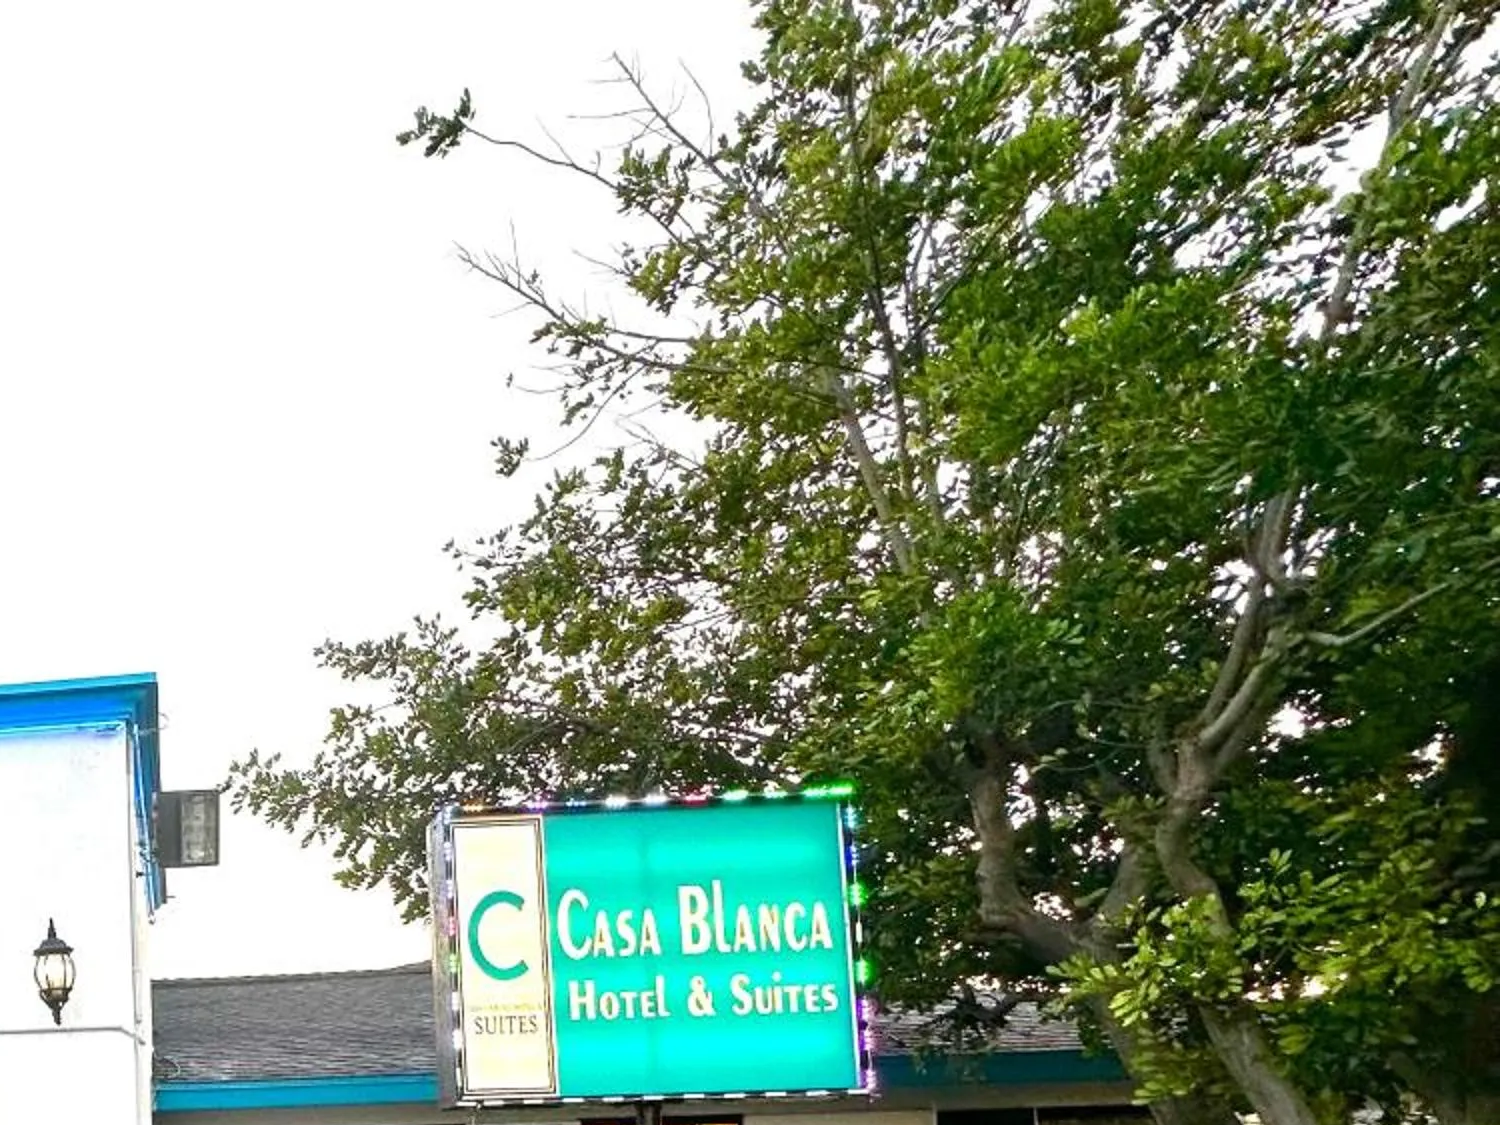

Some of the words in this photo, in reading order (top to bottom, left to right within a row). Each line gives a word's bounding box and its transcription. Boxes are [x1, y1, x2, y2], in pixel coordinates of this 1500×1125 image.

[467, 889, 530, 981] C
[557, 887, 662, 961] CASA
[677, 878, 834, 955] BLANCA
[473, 1014, 540, 1036] SUITES
[568, 974, 671, 1021] HOTEL
[687, 975, 717, 1017] &
